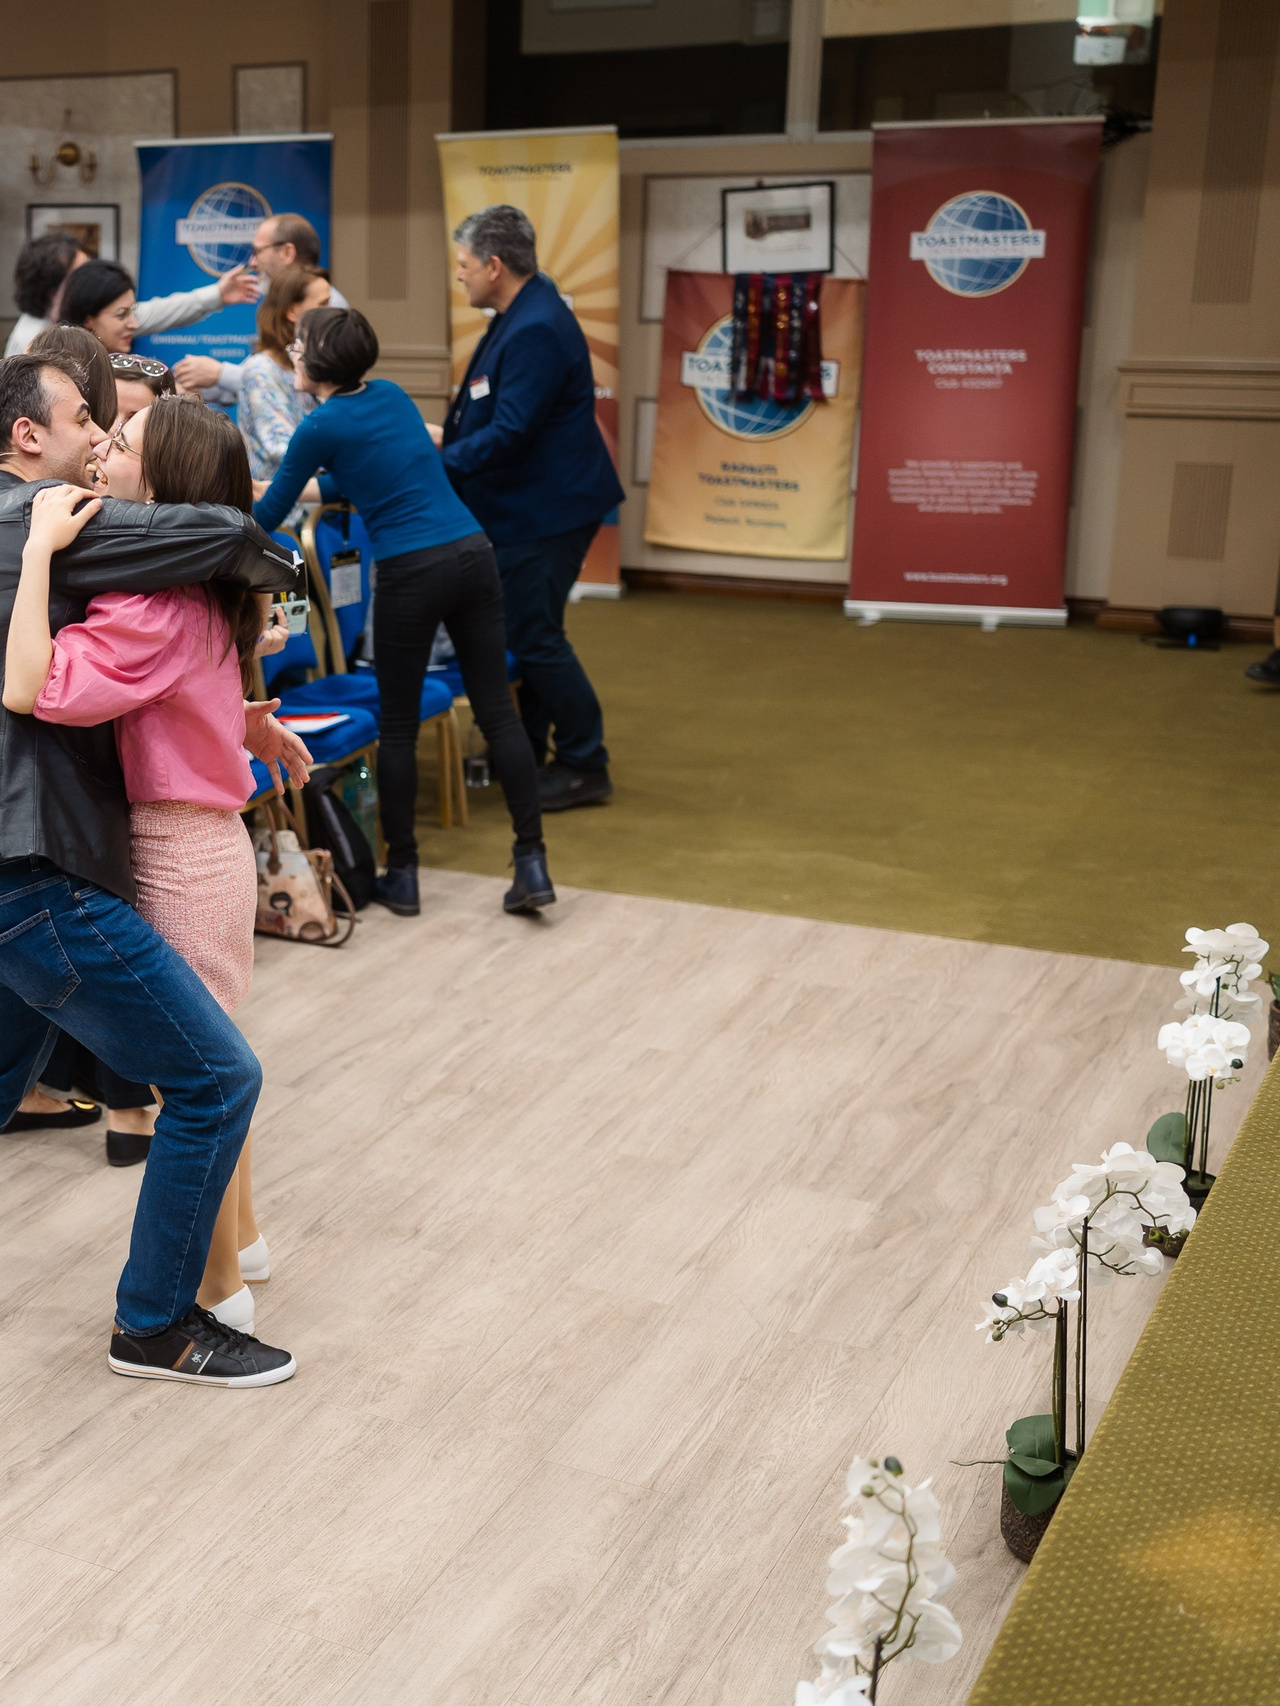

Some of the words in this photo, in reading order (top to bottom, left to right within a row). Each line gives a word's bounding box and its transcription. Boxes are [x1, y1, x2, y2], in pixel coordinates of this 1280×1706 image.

[917, 235, 1040, 247] TOASTMASTERS
[915, 349, 1027, 362] TOASTMASTERS
[699, 473, 799, 492] TOASTMASTERS
